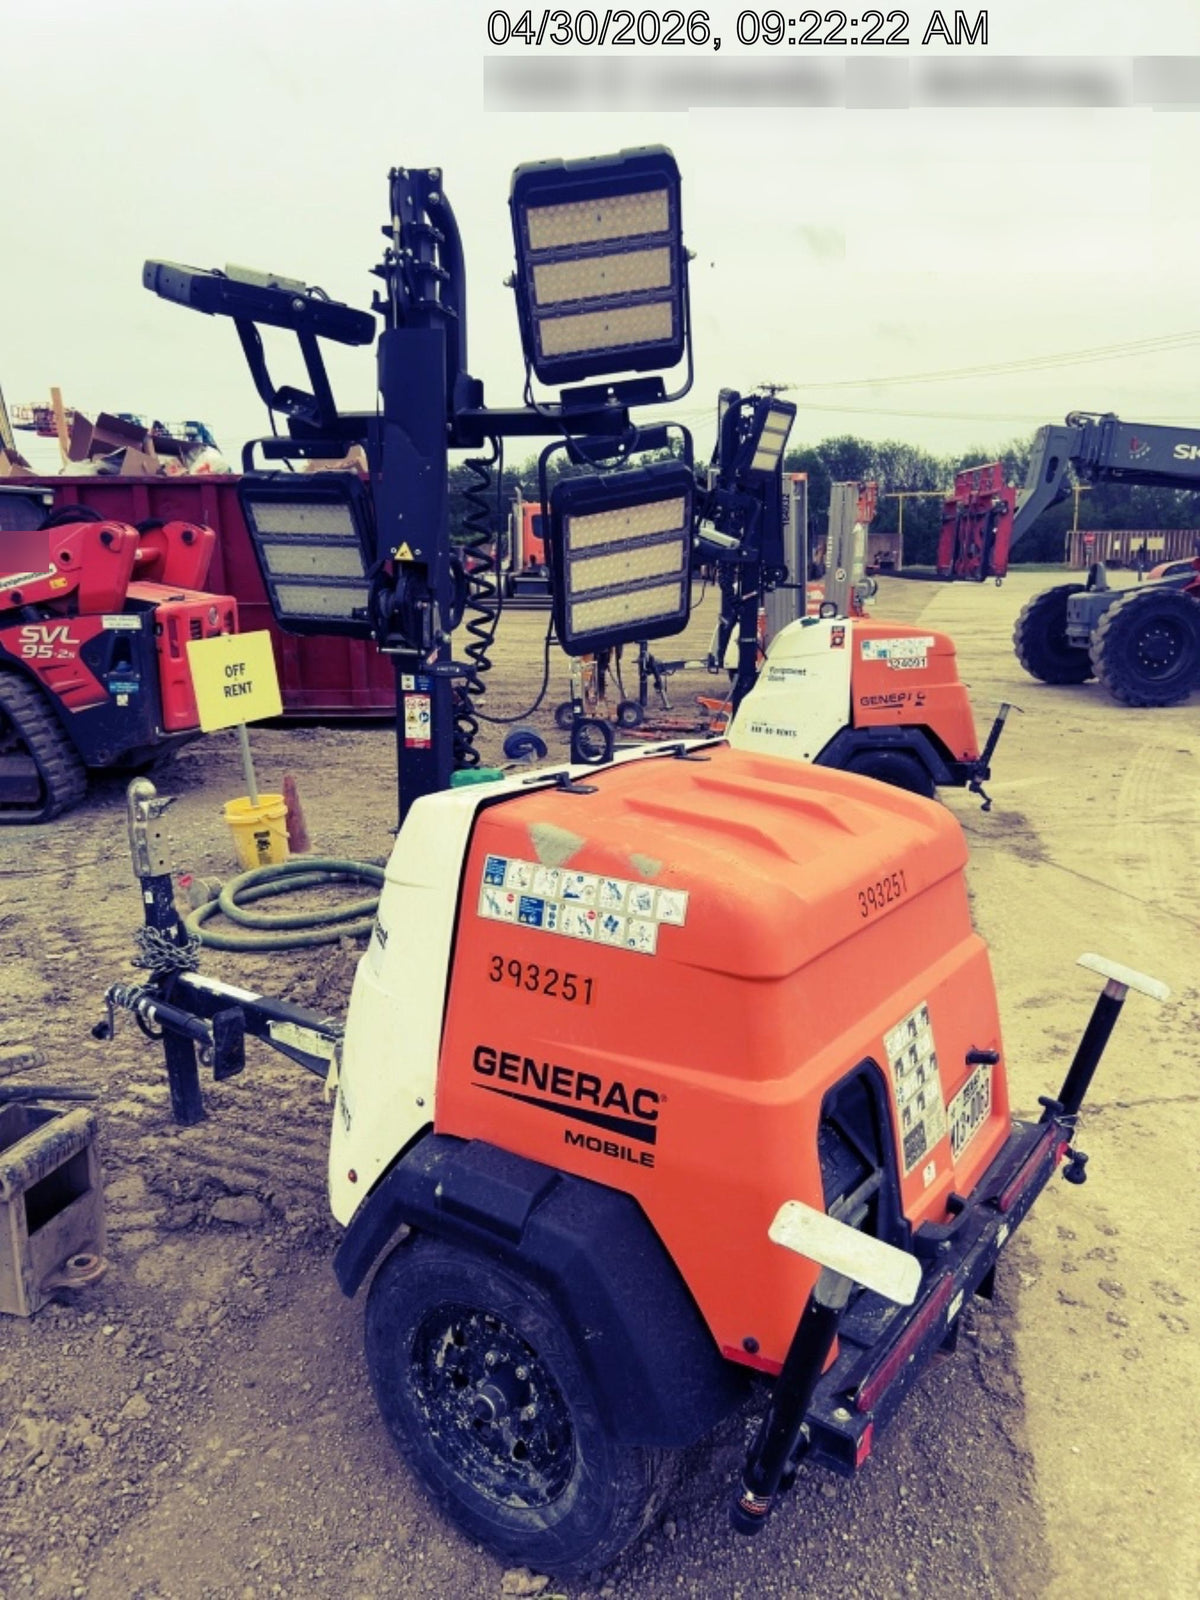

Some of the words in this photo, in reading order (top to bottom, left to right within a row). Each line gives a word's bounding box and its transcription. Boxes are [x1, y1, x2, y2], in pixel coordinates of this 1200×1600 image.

[18, 625, 81, 644] SVL
[223, 681, 253, 698] RENT
[225, 663, 246, 678] OFF
[858, 870, 907, 919] 393251
[489, 955, 594, 1006] 393251
[473, 1045, 660, 1121] GENERAC
[564, 1129, 656, 1169] MOBILE
